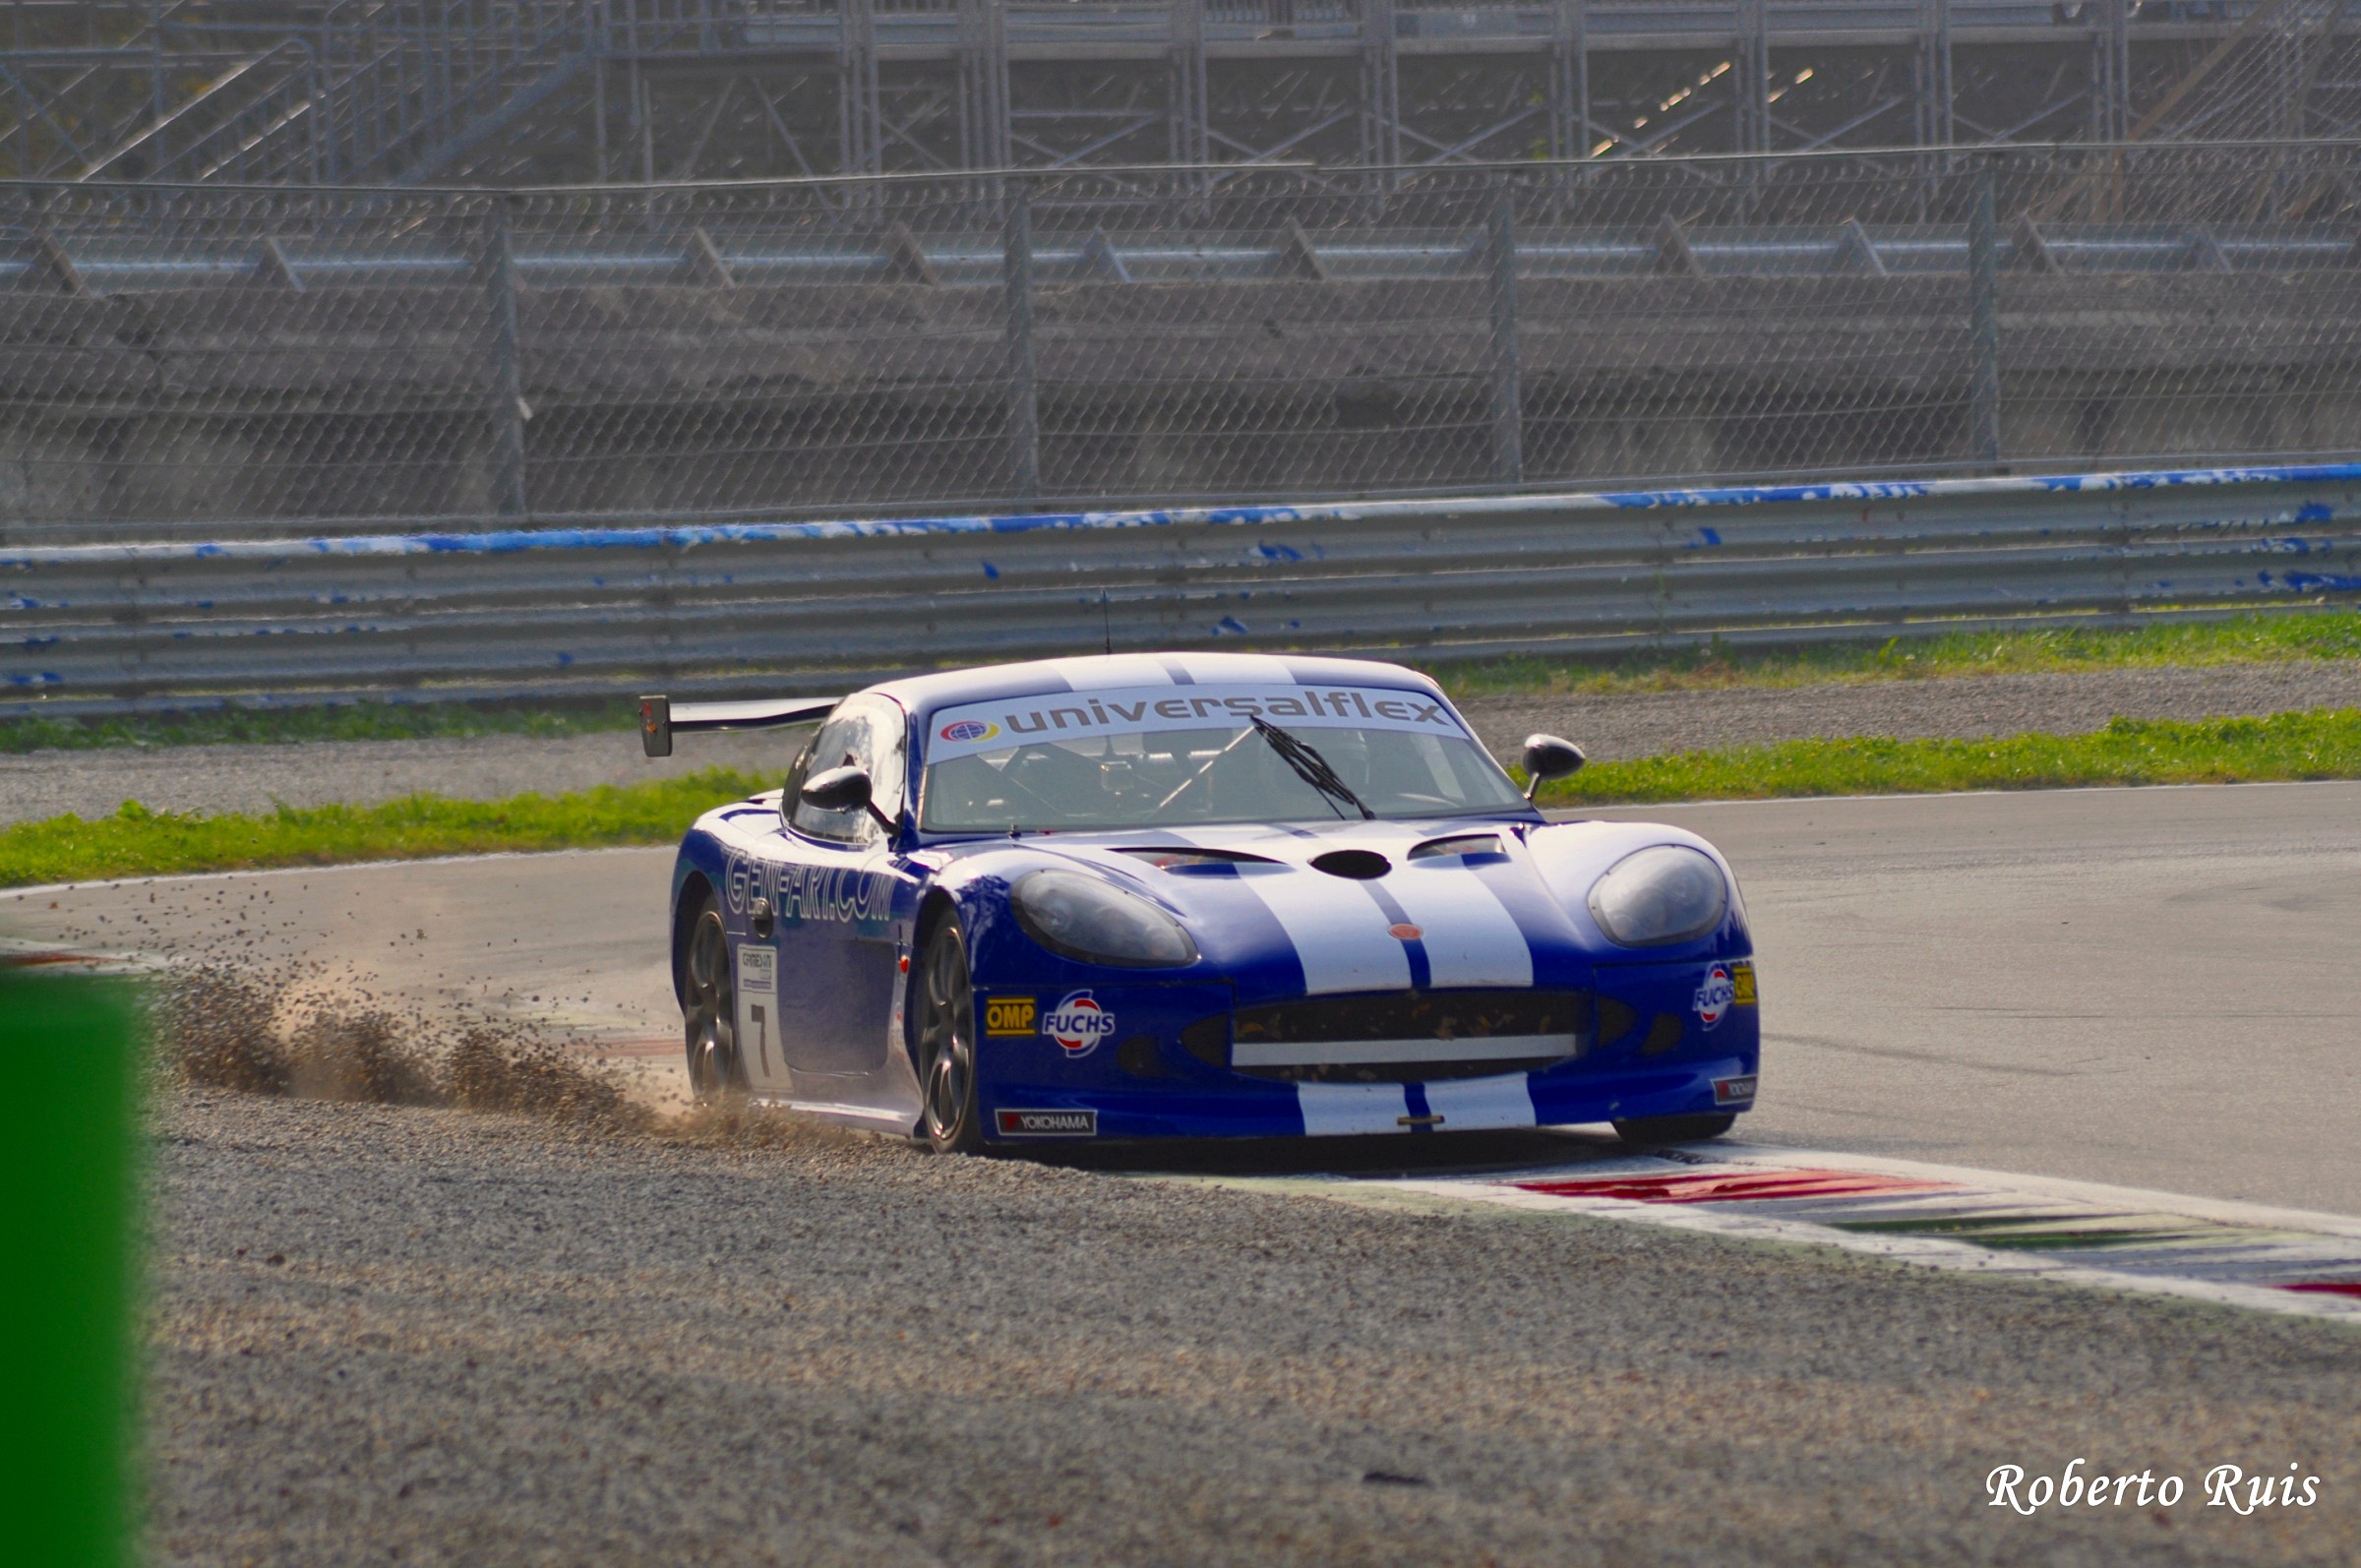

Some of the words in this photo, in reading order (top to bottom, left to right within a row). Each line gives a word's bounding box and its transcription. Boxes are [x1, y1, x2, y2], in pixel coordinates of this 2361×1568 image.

[1005, 692, 1448, 734] universalflex
[987, 1004, 1034, 1029] OMP
[1044, 1014, 1114, 1034] FUCHS
[751, 1004, 770, 1078] 7
[1020, 1115, 1089, 1129] YOKOHAMA
